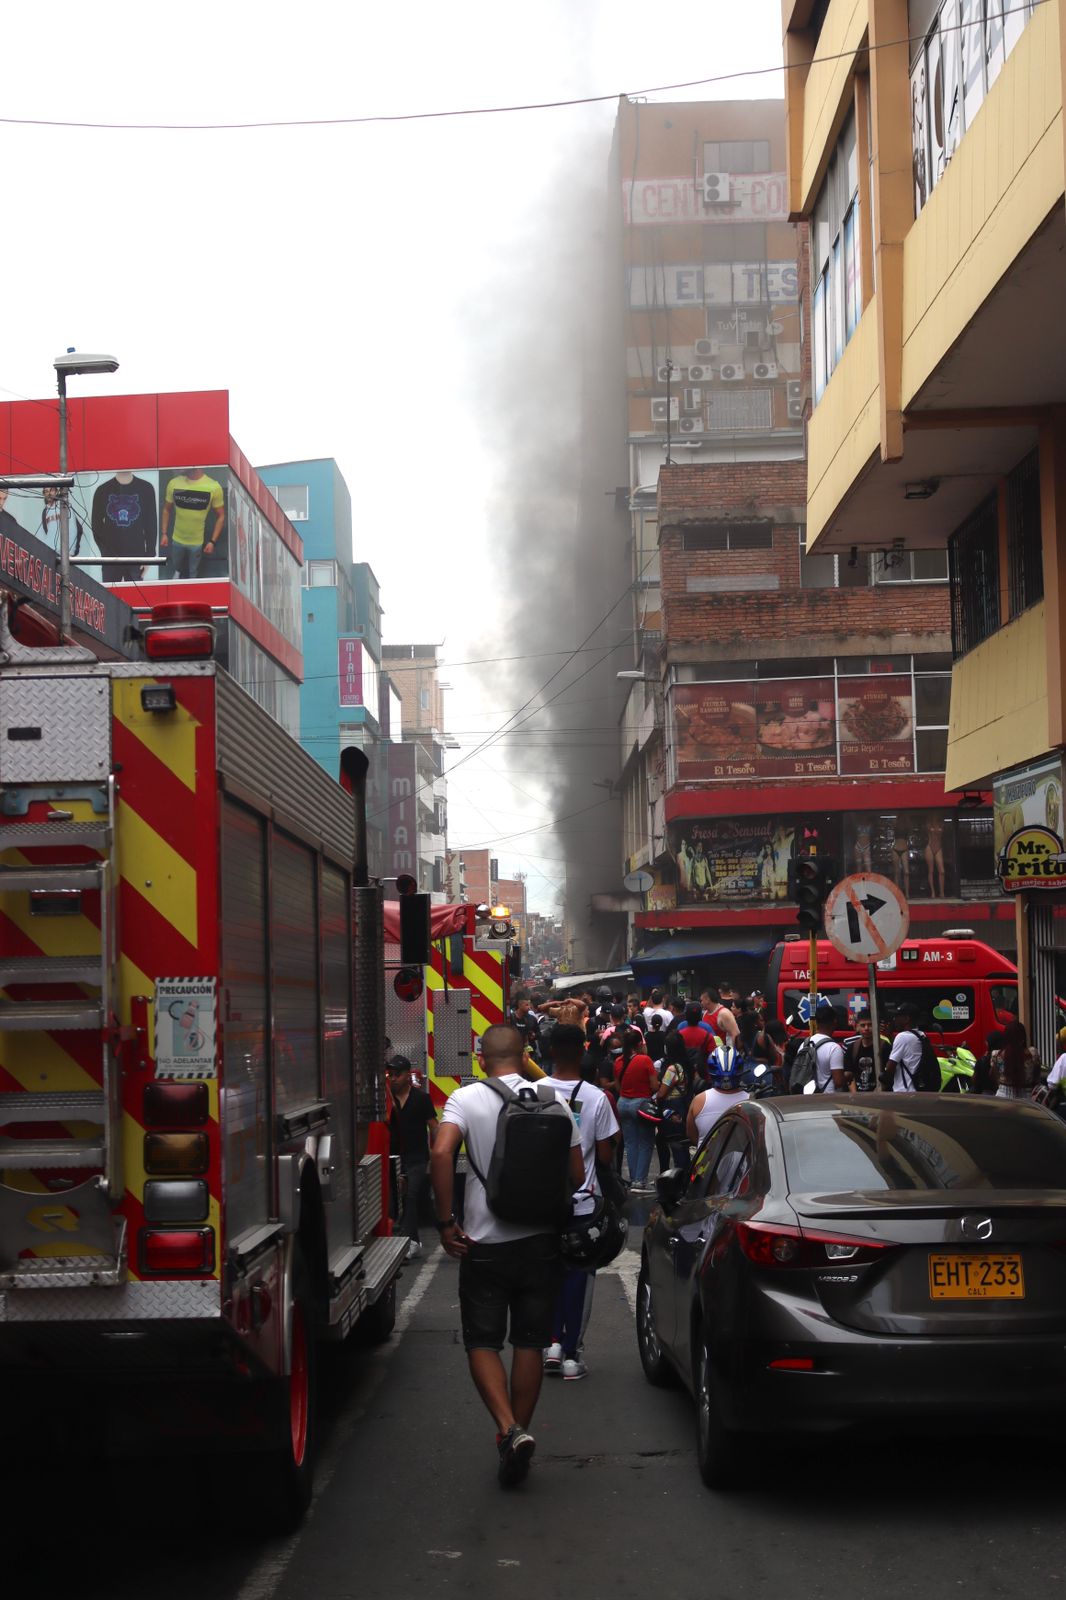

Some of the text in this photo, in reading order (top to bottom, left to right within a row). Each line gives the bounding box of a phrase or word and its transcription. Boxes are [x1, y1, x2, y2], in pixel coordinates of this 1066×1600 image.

[642, 179, 788, 217] CENT CO
[676, 270, 714, 300] EL
[0, 533, 106, 634] VENTAS AL PR MAYOR
[714, 764, 756, 775] El Tesoro
[794, 761, 836, 772] El Tesoro
[869, 758, 911, 769] El Tesoro
[733, 821, 772, 838] Sensual
[1017, 841, 1050, 855] Mr.
[1022, 880, 1045, 888] mejor
[159, 985, 212, 995] PRECAUCIÓN
[933, 1262, 1020, 1286] EHT 233
[967, 1287, 987, 1296] CALI
